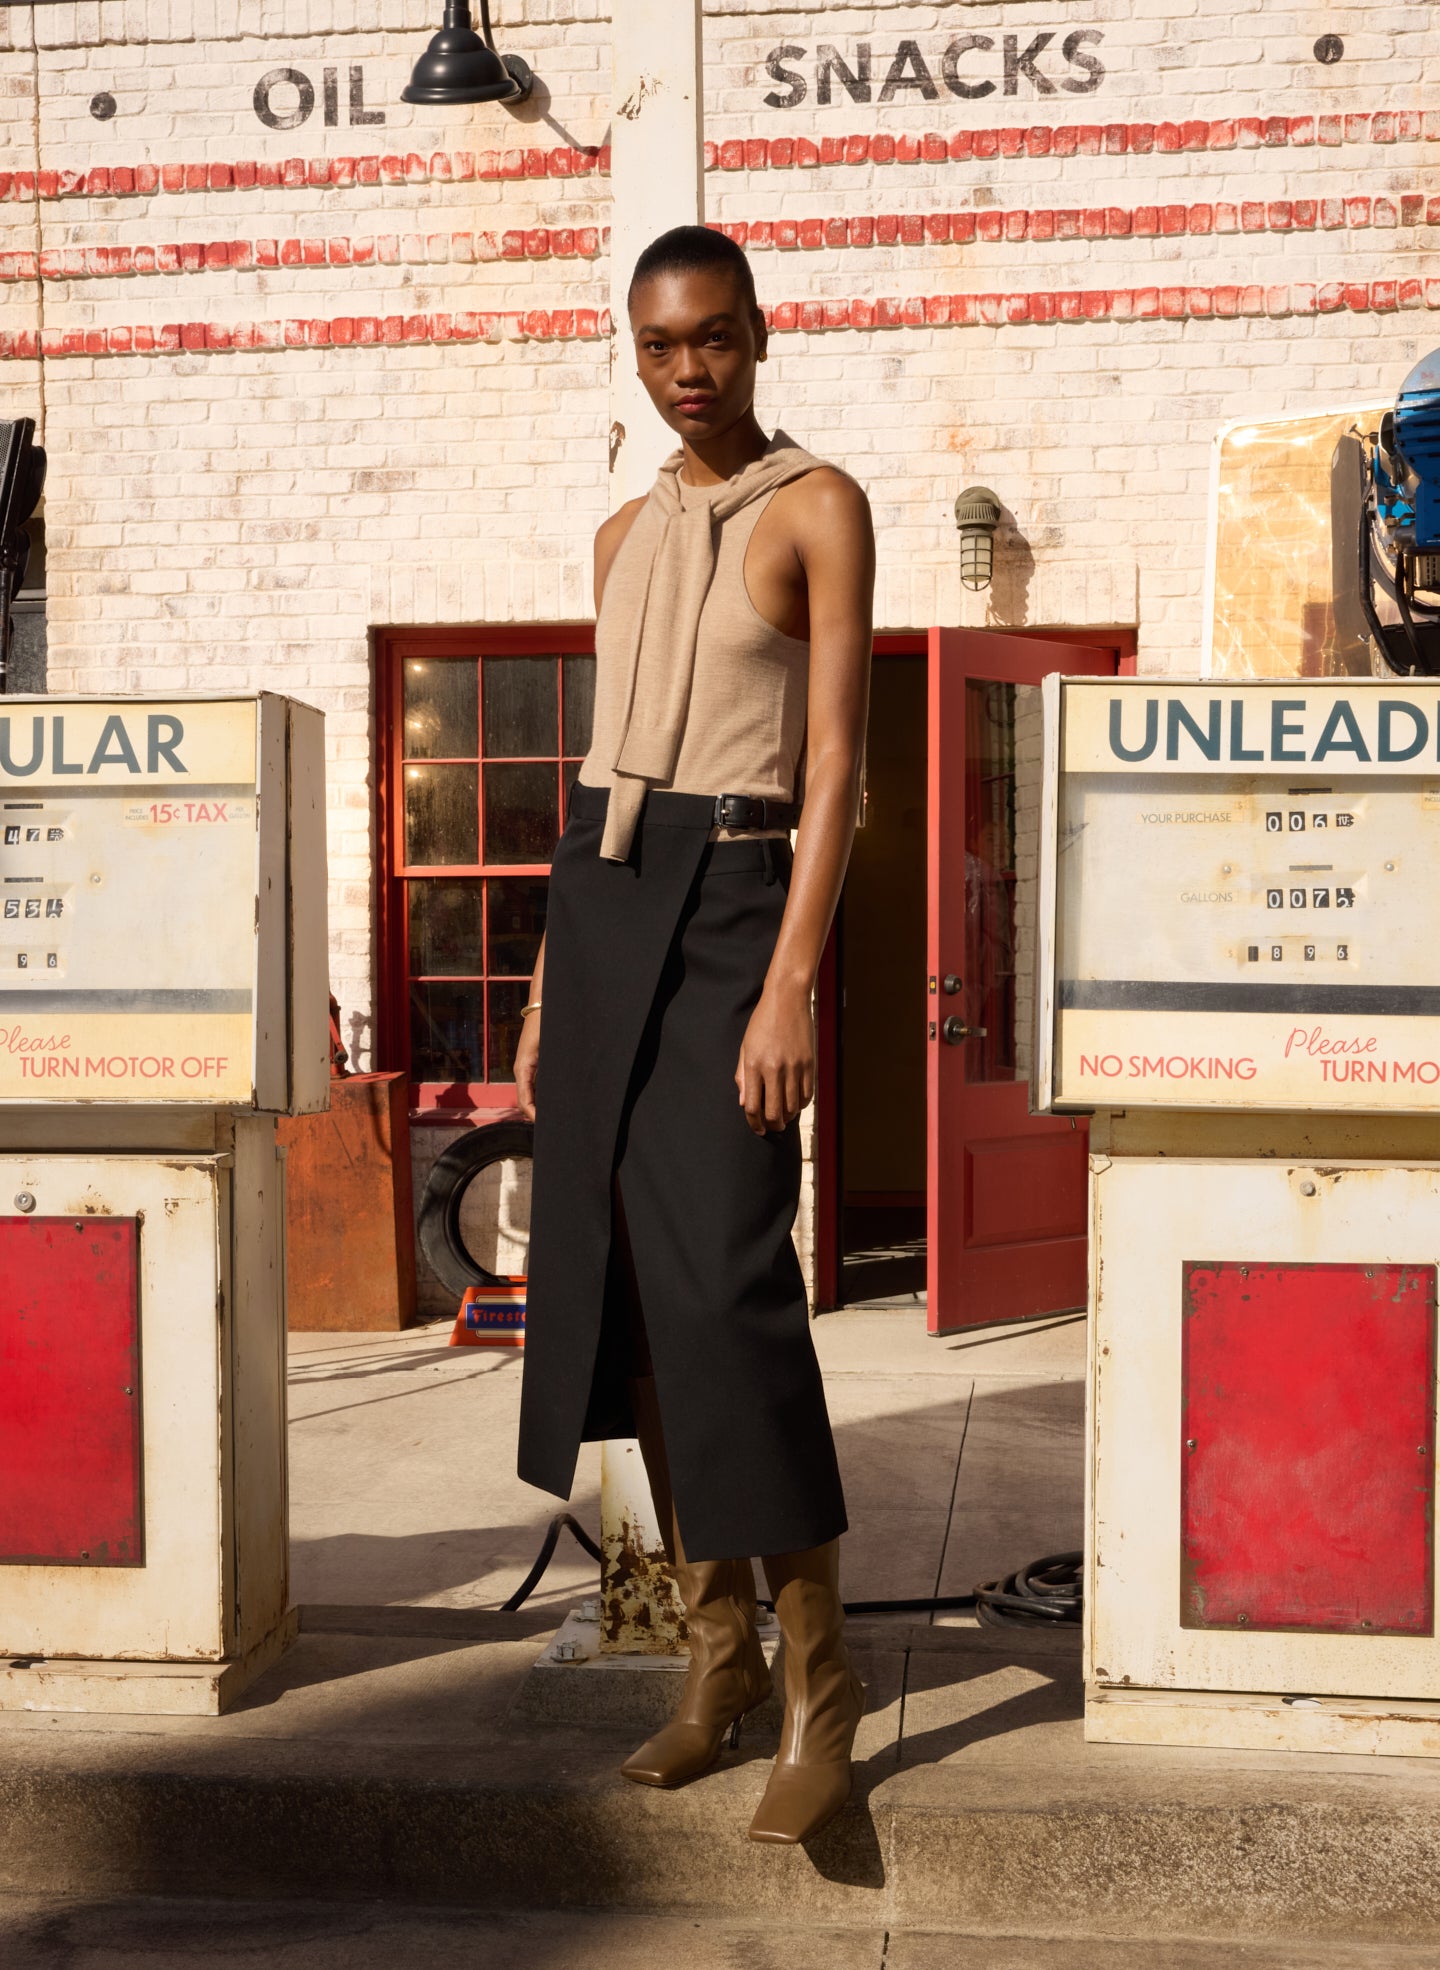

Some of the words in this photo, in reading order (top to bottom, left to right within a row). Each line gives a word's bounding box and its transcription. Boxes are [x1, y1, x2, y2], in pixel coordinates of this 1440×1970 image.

[762, 29, 1107, 109] SNACKS
[252, 65, 386, 130] OIL
[1108, 699, 1440, 763] UNLEAD
[0, 714, 189, 777] ULAR
[184, 803, 228, 822] TAX
[1141, 813, 1172, 824] YOUR
[1175, 812, 1232, 823] PURCHASE
[1180, 892, 1233, 903] GALLONS
[1283, 1026, 1378, 1058] Please
[20, 1056, 79, 1078] TURN
[85, 1056, 175, 1079] MOTOR
[181, 1056, 229, 1079] OFF
[1079, 1054, 1123, 1077] NO
[1129, 1055, 1258, 1081] SMOKING
[1320, 1060, 1386, 1082] TURN
[1393, 1061, 1440, 1085] MO
